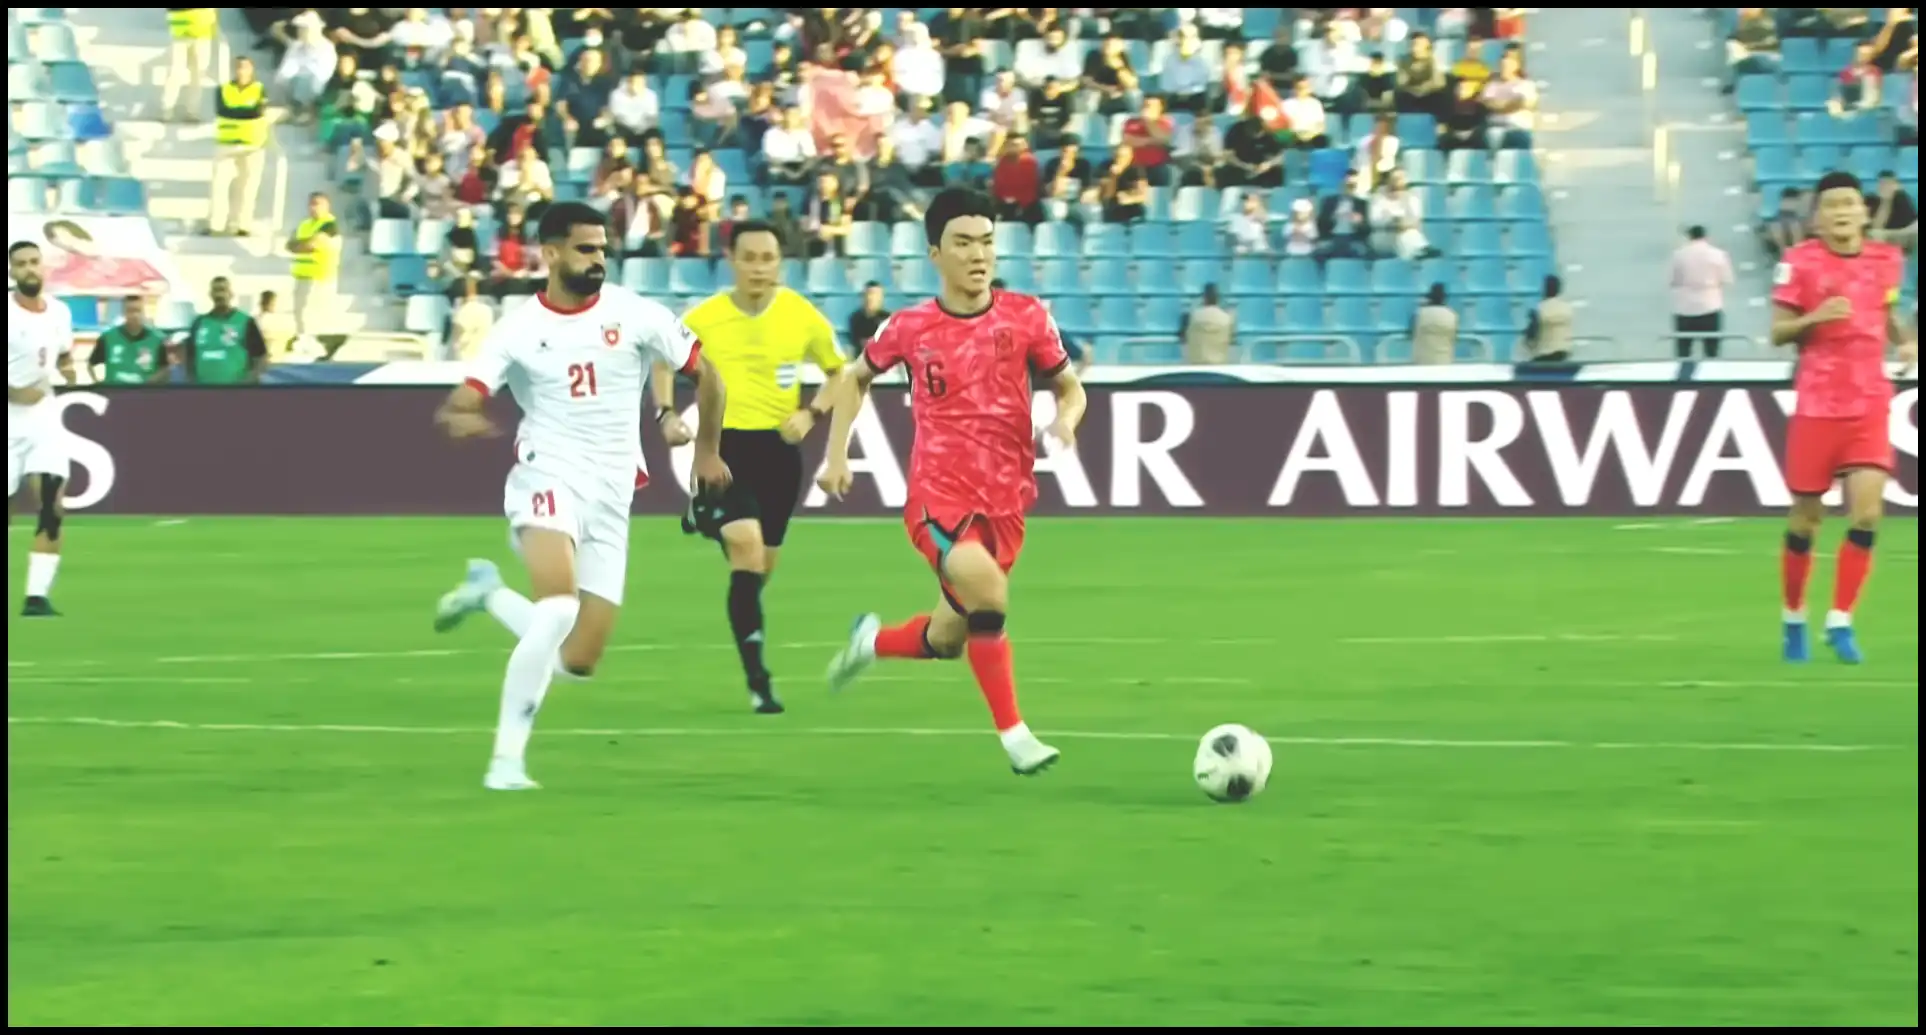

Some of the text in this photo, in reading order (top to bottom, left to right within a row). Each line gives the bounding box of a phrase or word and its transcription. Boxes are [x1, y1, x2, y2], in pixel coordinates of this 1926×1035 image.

[568, 361, 597, 398] 21
[926, 360, 947, 397] 6
[670, 388, 1204, 507] AAR
[532, 489, 556, 517] 21
